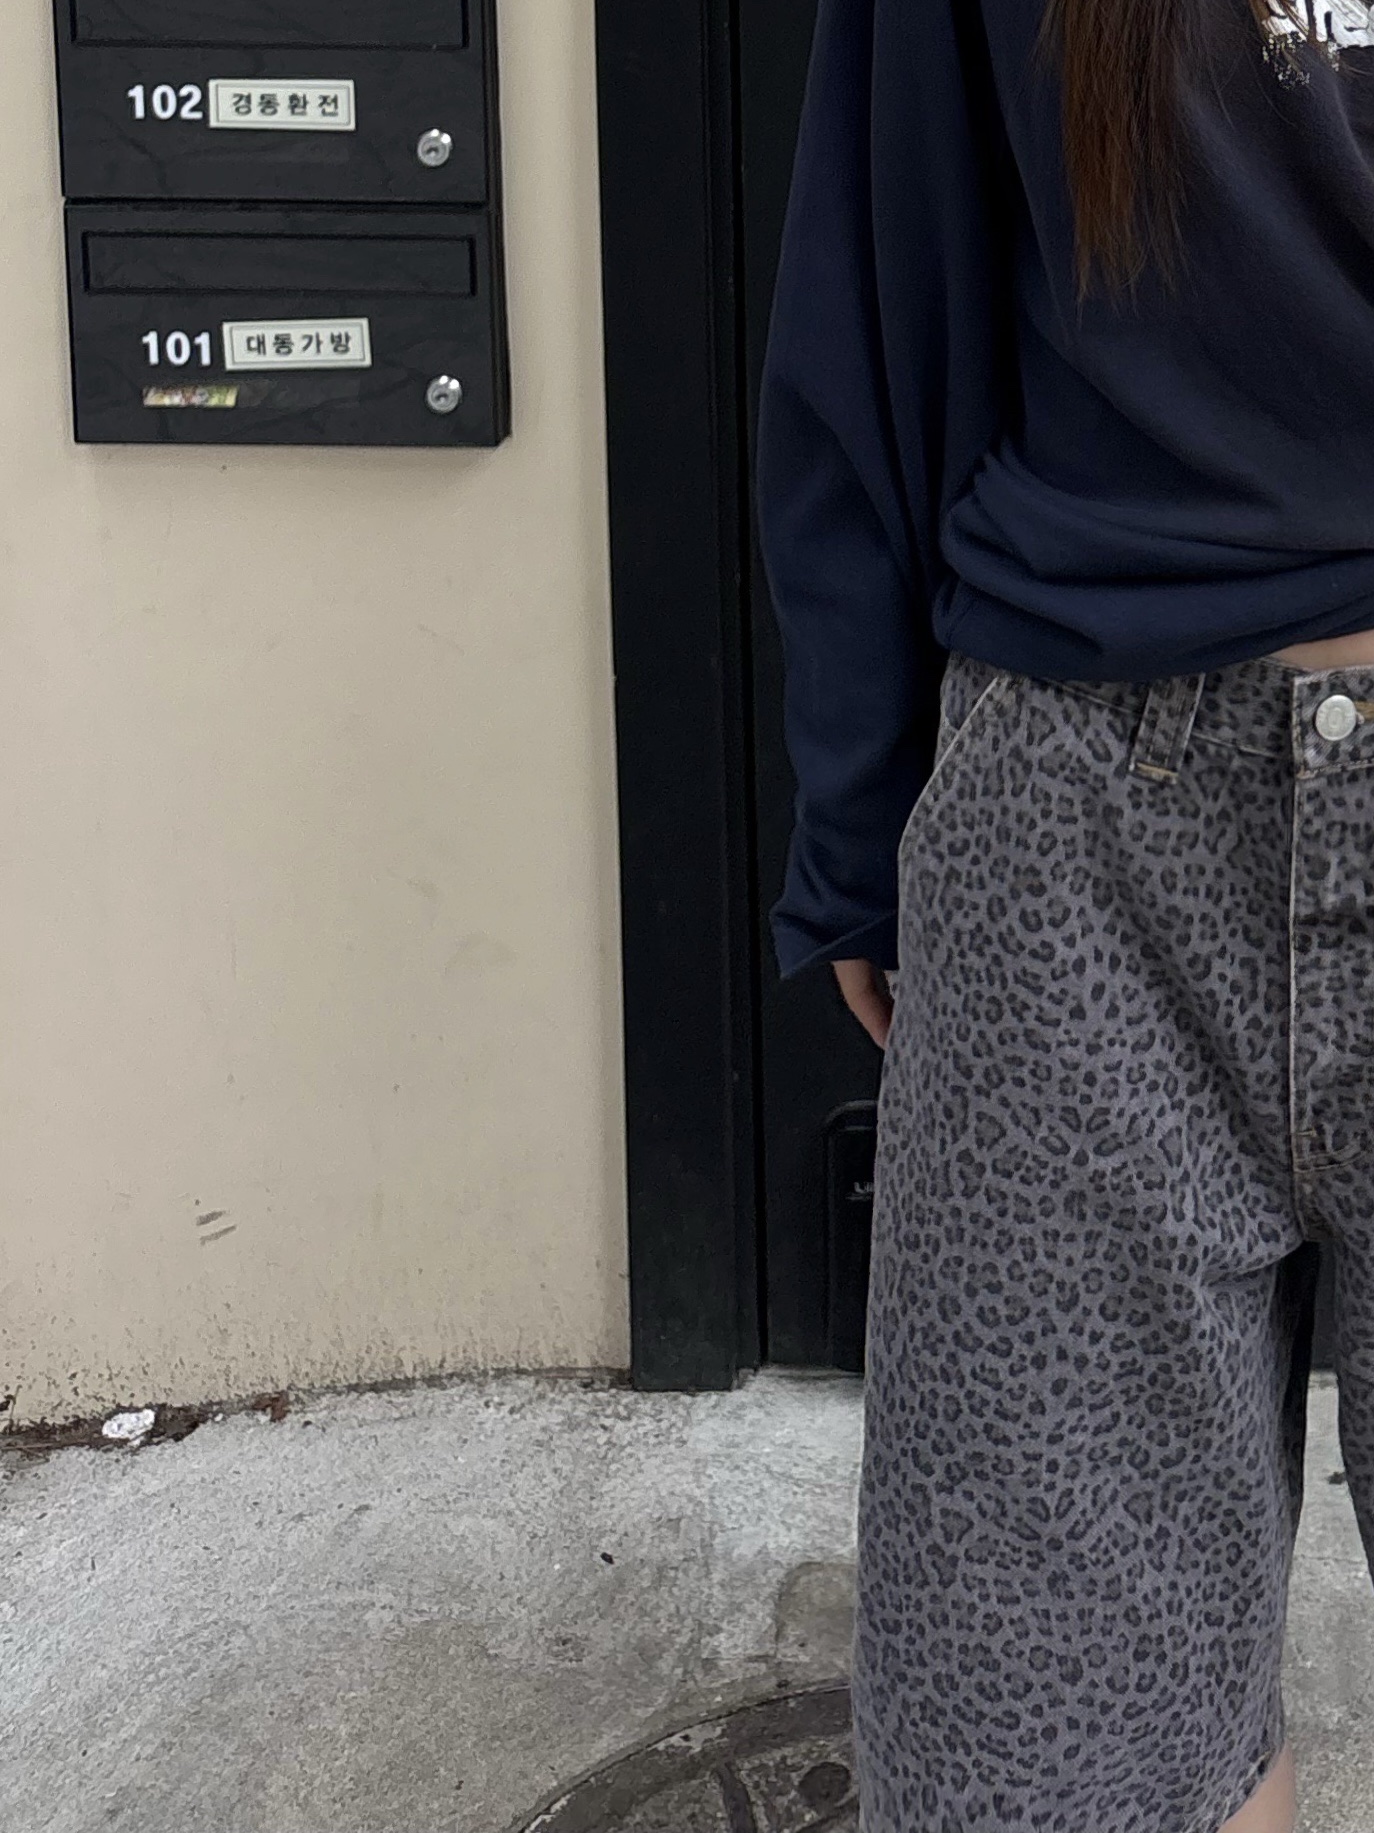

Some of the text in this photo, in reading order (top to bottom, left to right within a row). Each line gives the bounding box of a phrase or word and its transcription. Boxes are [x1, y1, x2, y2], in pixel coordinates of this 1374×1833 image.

[127, 84, 340, 120] 102 경동환전
[141, 330, 352, 366] 101 대동가방
